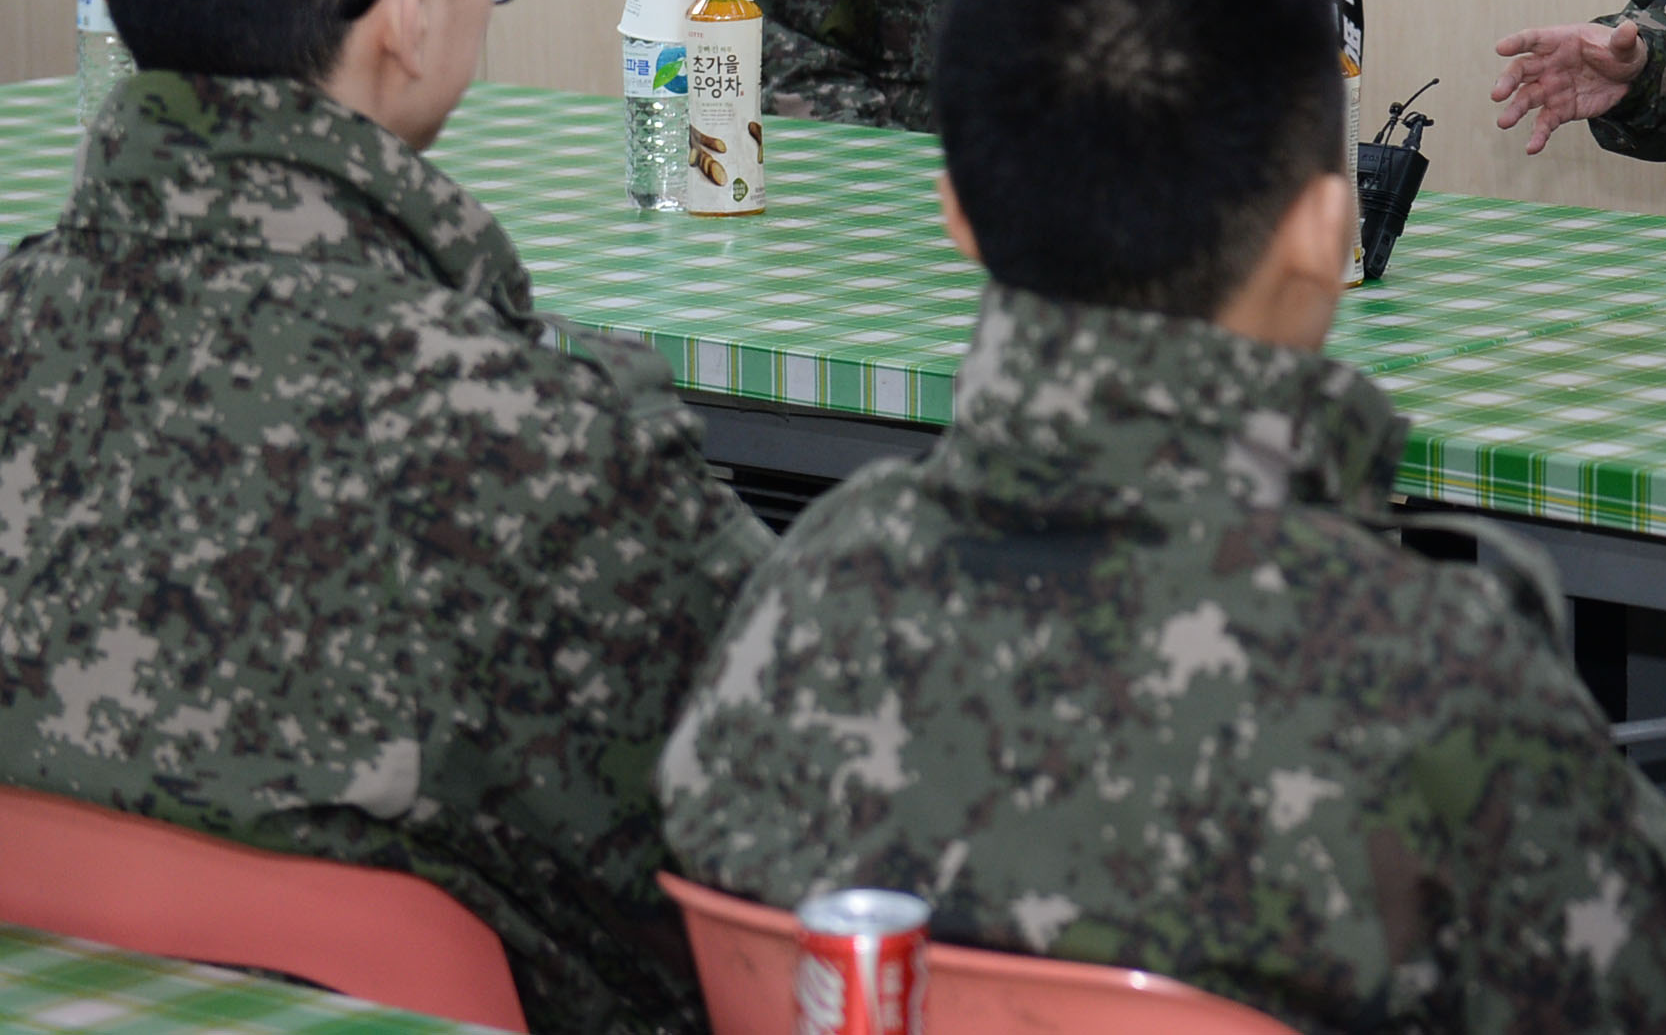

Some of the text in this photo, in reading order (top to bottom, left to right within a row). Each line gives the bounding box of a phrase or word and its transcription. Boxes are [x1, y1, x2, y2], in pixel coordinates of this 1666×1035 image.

[624, 59, 651, 76] 파클
[693, 54, 740, 74] 초가을
[693, 75, 742, 99] 우엉차
